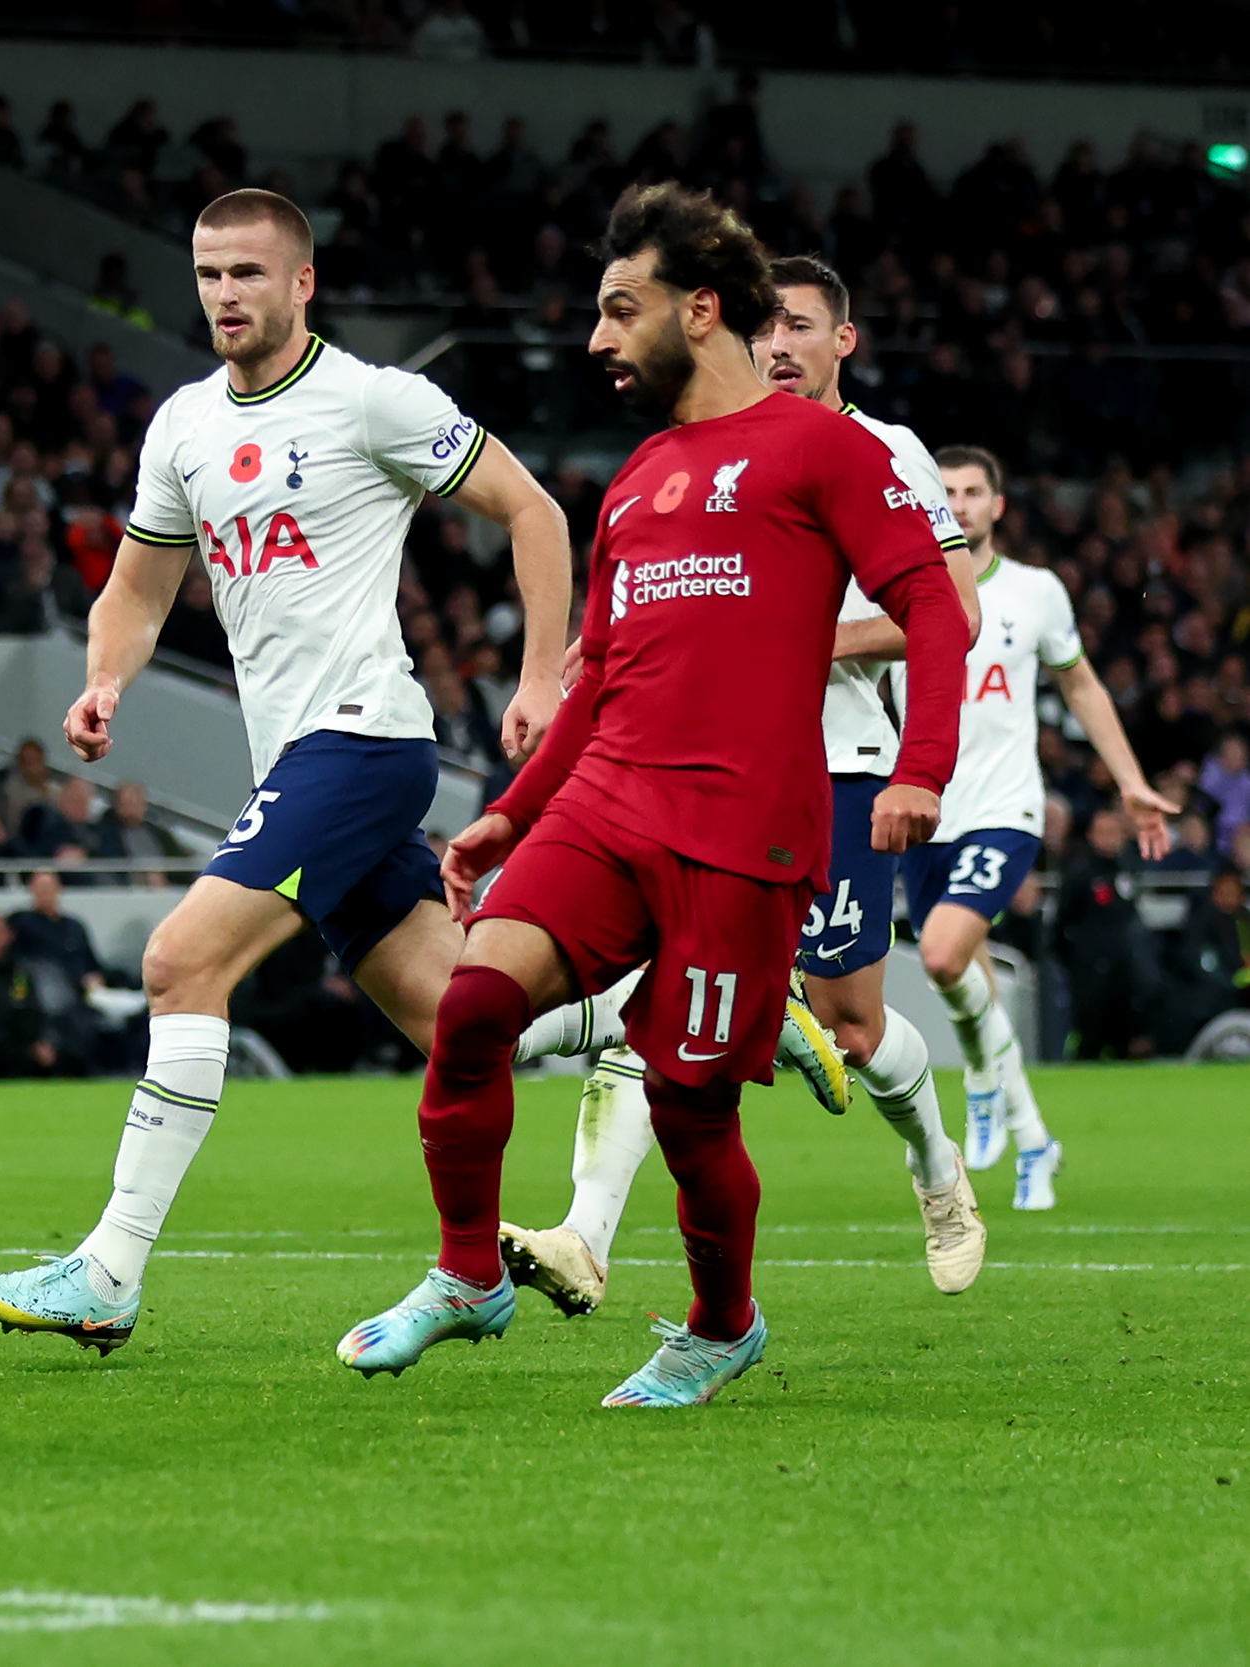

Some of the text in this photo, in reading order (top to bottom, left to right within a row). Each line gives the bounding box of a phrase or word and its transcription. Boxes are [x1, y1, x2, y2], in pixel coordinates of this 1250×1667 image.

[202, 512, 321, 578] AIA
[632, 553, 743, 584] standard
[632, 575, 751, 605] chartered
[949, 844, 1009, 890] 33
[685, 965, 737, 1043] 11
